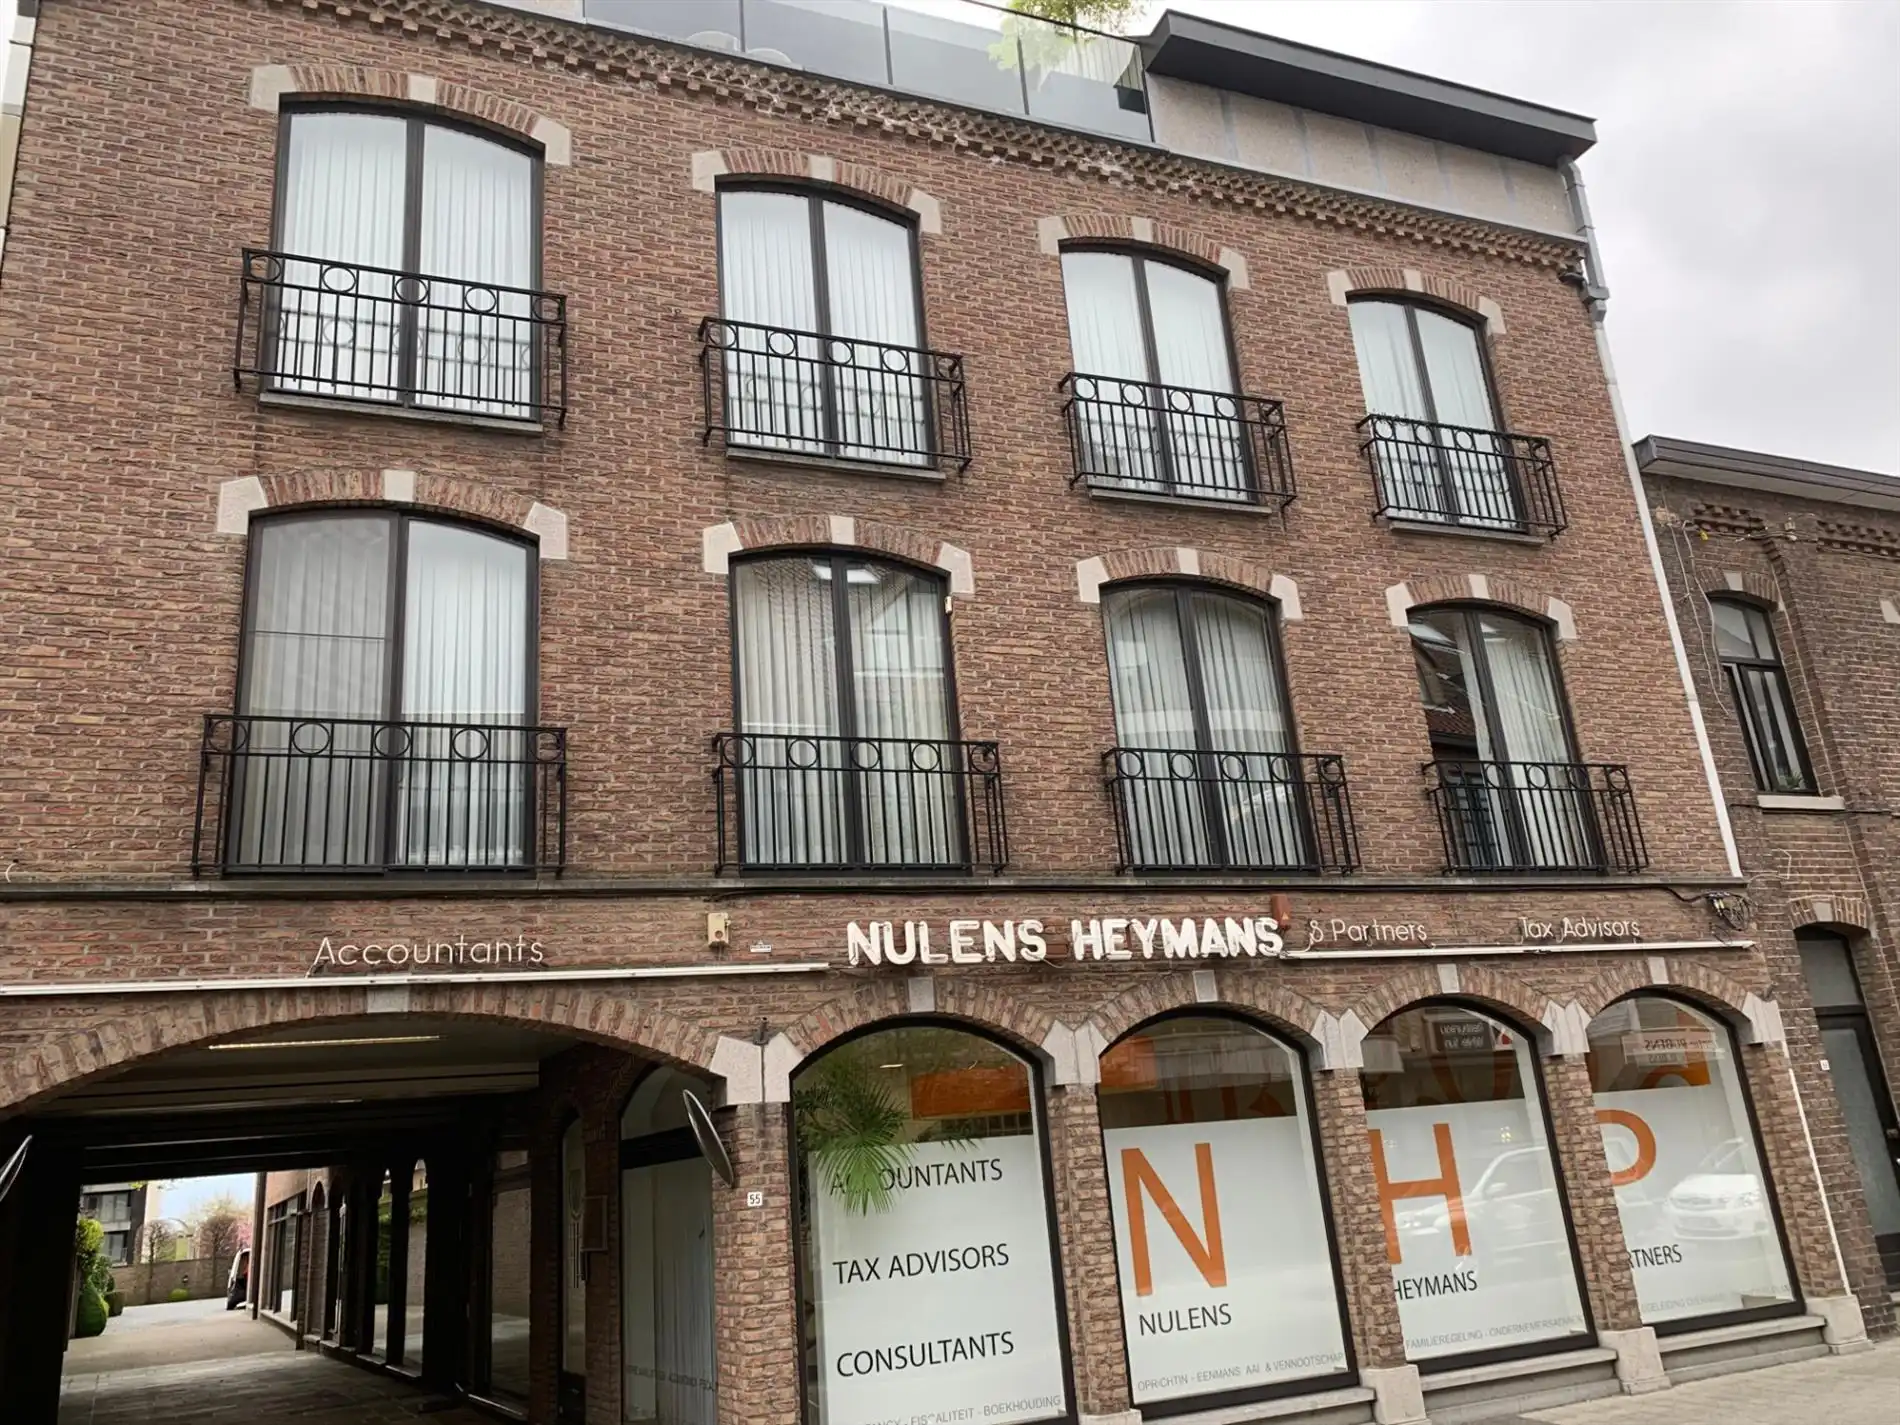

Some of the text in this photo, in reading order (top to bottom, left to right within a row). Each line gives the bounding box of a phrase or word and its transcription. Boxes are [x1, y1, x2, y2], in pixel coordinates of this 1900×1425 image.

[847, 919, 1047, 966] NULENS
[1071, 917, 1284, 961] HEYMANS
[1332, 919, 1427, 943] Partners
[1520, 916, 1640, 938] Tax Advisors
[314, 934, 544, 967] Accountants
[750, 1194, 760, 1204] 55
[1367, 1123, 1472, 1265] H
[1121, 1143, 1227, 1297] N
[832, 1243, 1010, 1285] TAX ADVISORS
[1393, 1270, 1477, 1300] HEYMANS
[1139, 1303, 1232, 1337] NULENS
[837, 1331, 1015, 1378] CONSULTANTS
[983, 1395, 1060, 1416] BOEKHOUDING
